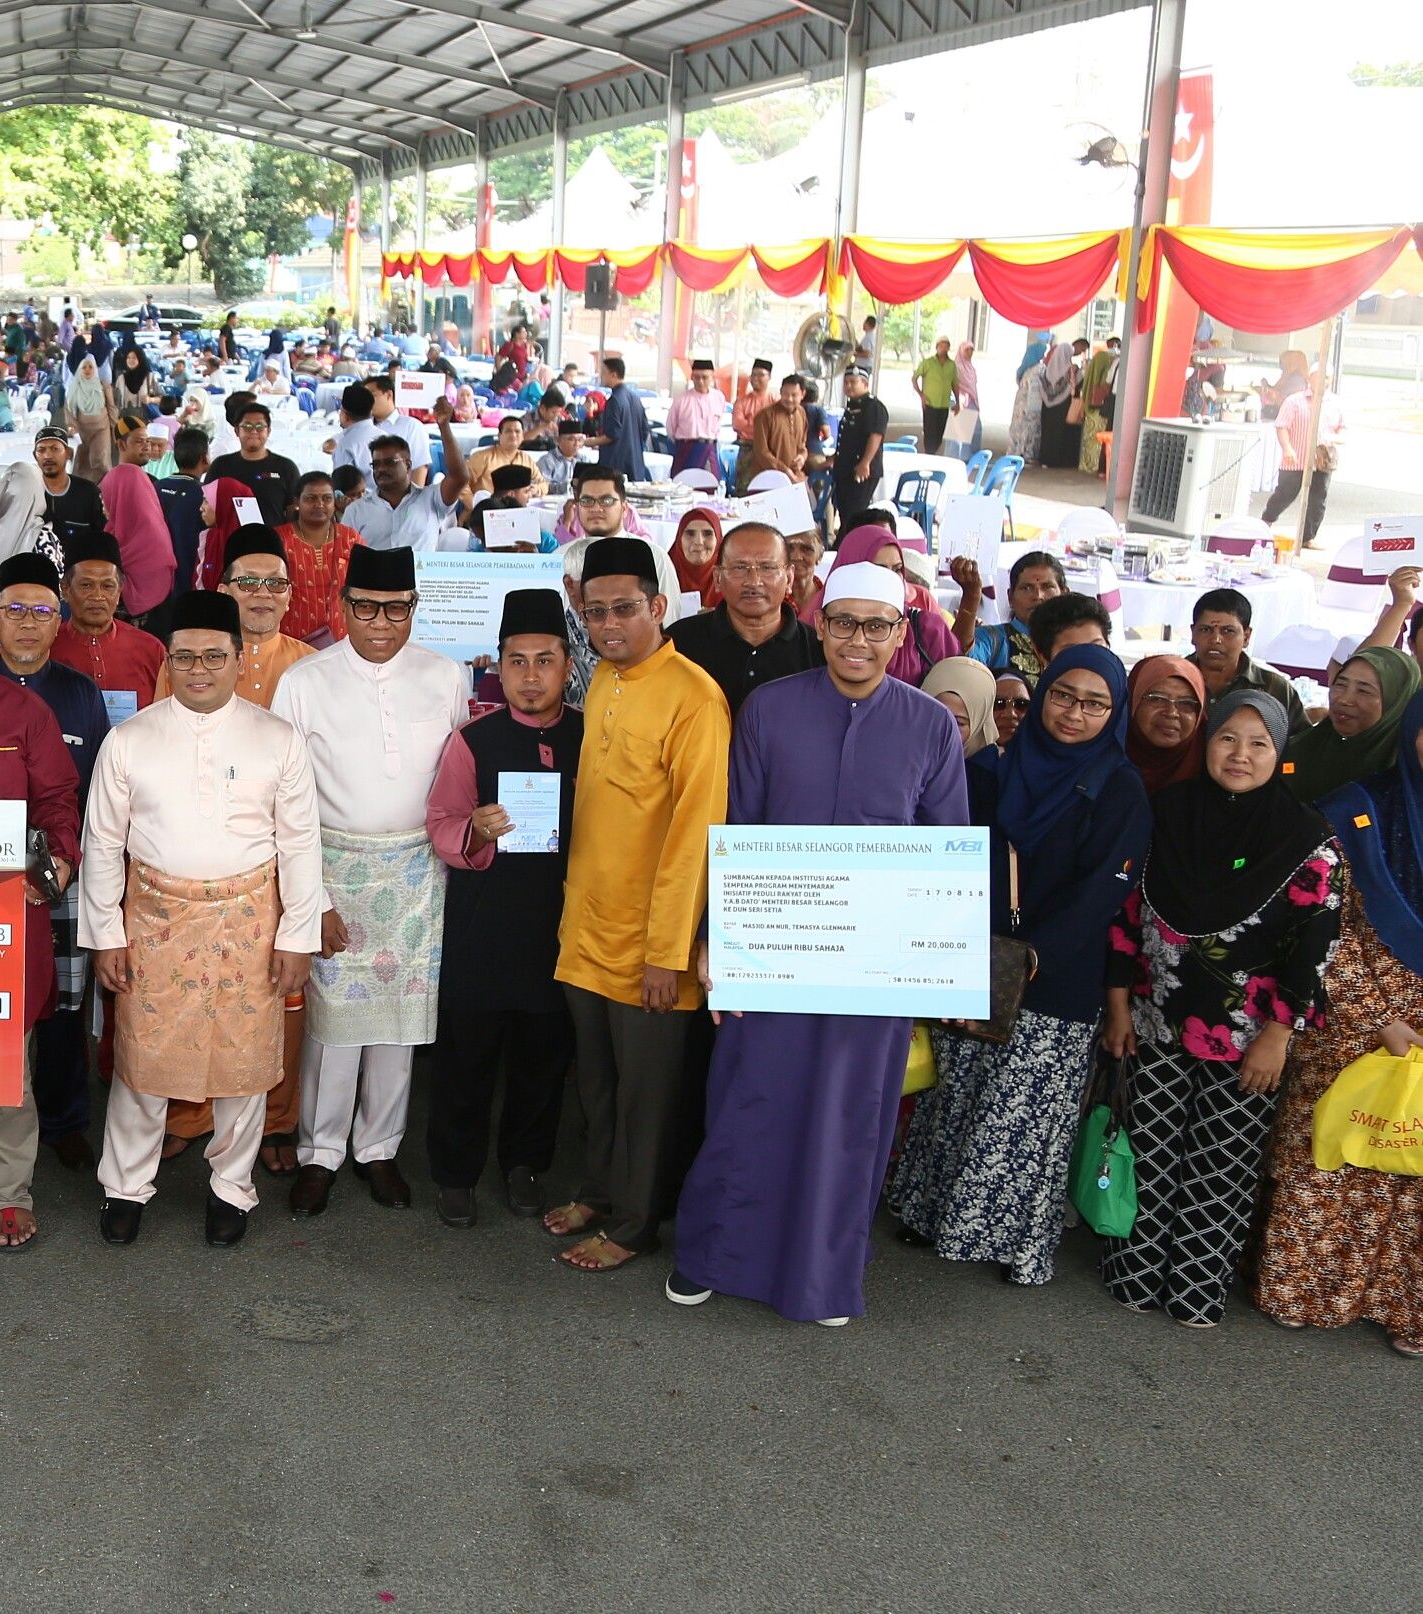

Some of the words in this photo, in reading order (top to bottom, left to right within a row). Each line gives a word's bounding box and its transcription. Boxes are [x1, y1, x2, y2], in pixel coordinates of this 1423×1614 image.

[732, 842, 774, 852] MENTERI
[776, 842, 803, 852] BESAR
[805, 842, 853, 853] SELANGOR
[856, 843, 932, 854] PEMERBADANAN
[794, 944, 813, 952] RIBU
[928, 942, 967, 950] 20,000.00
